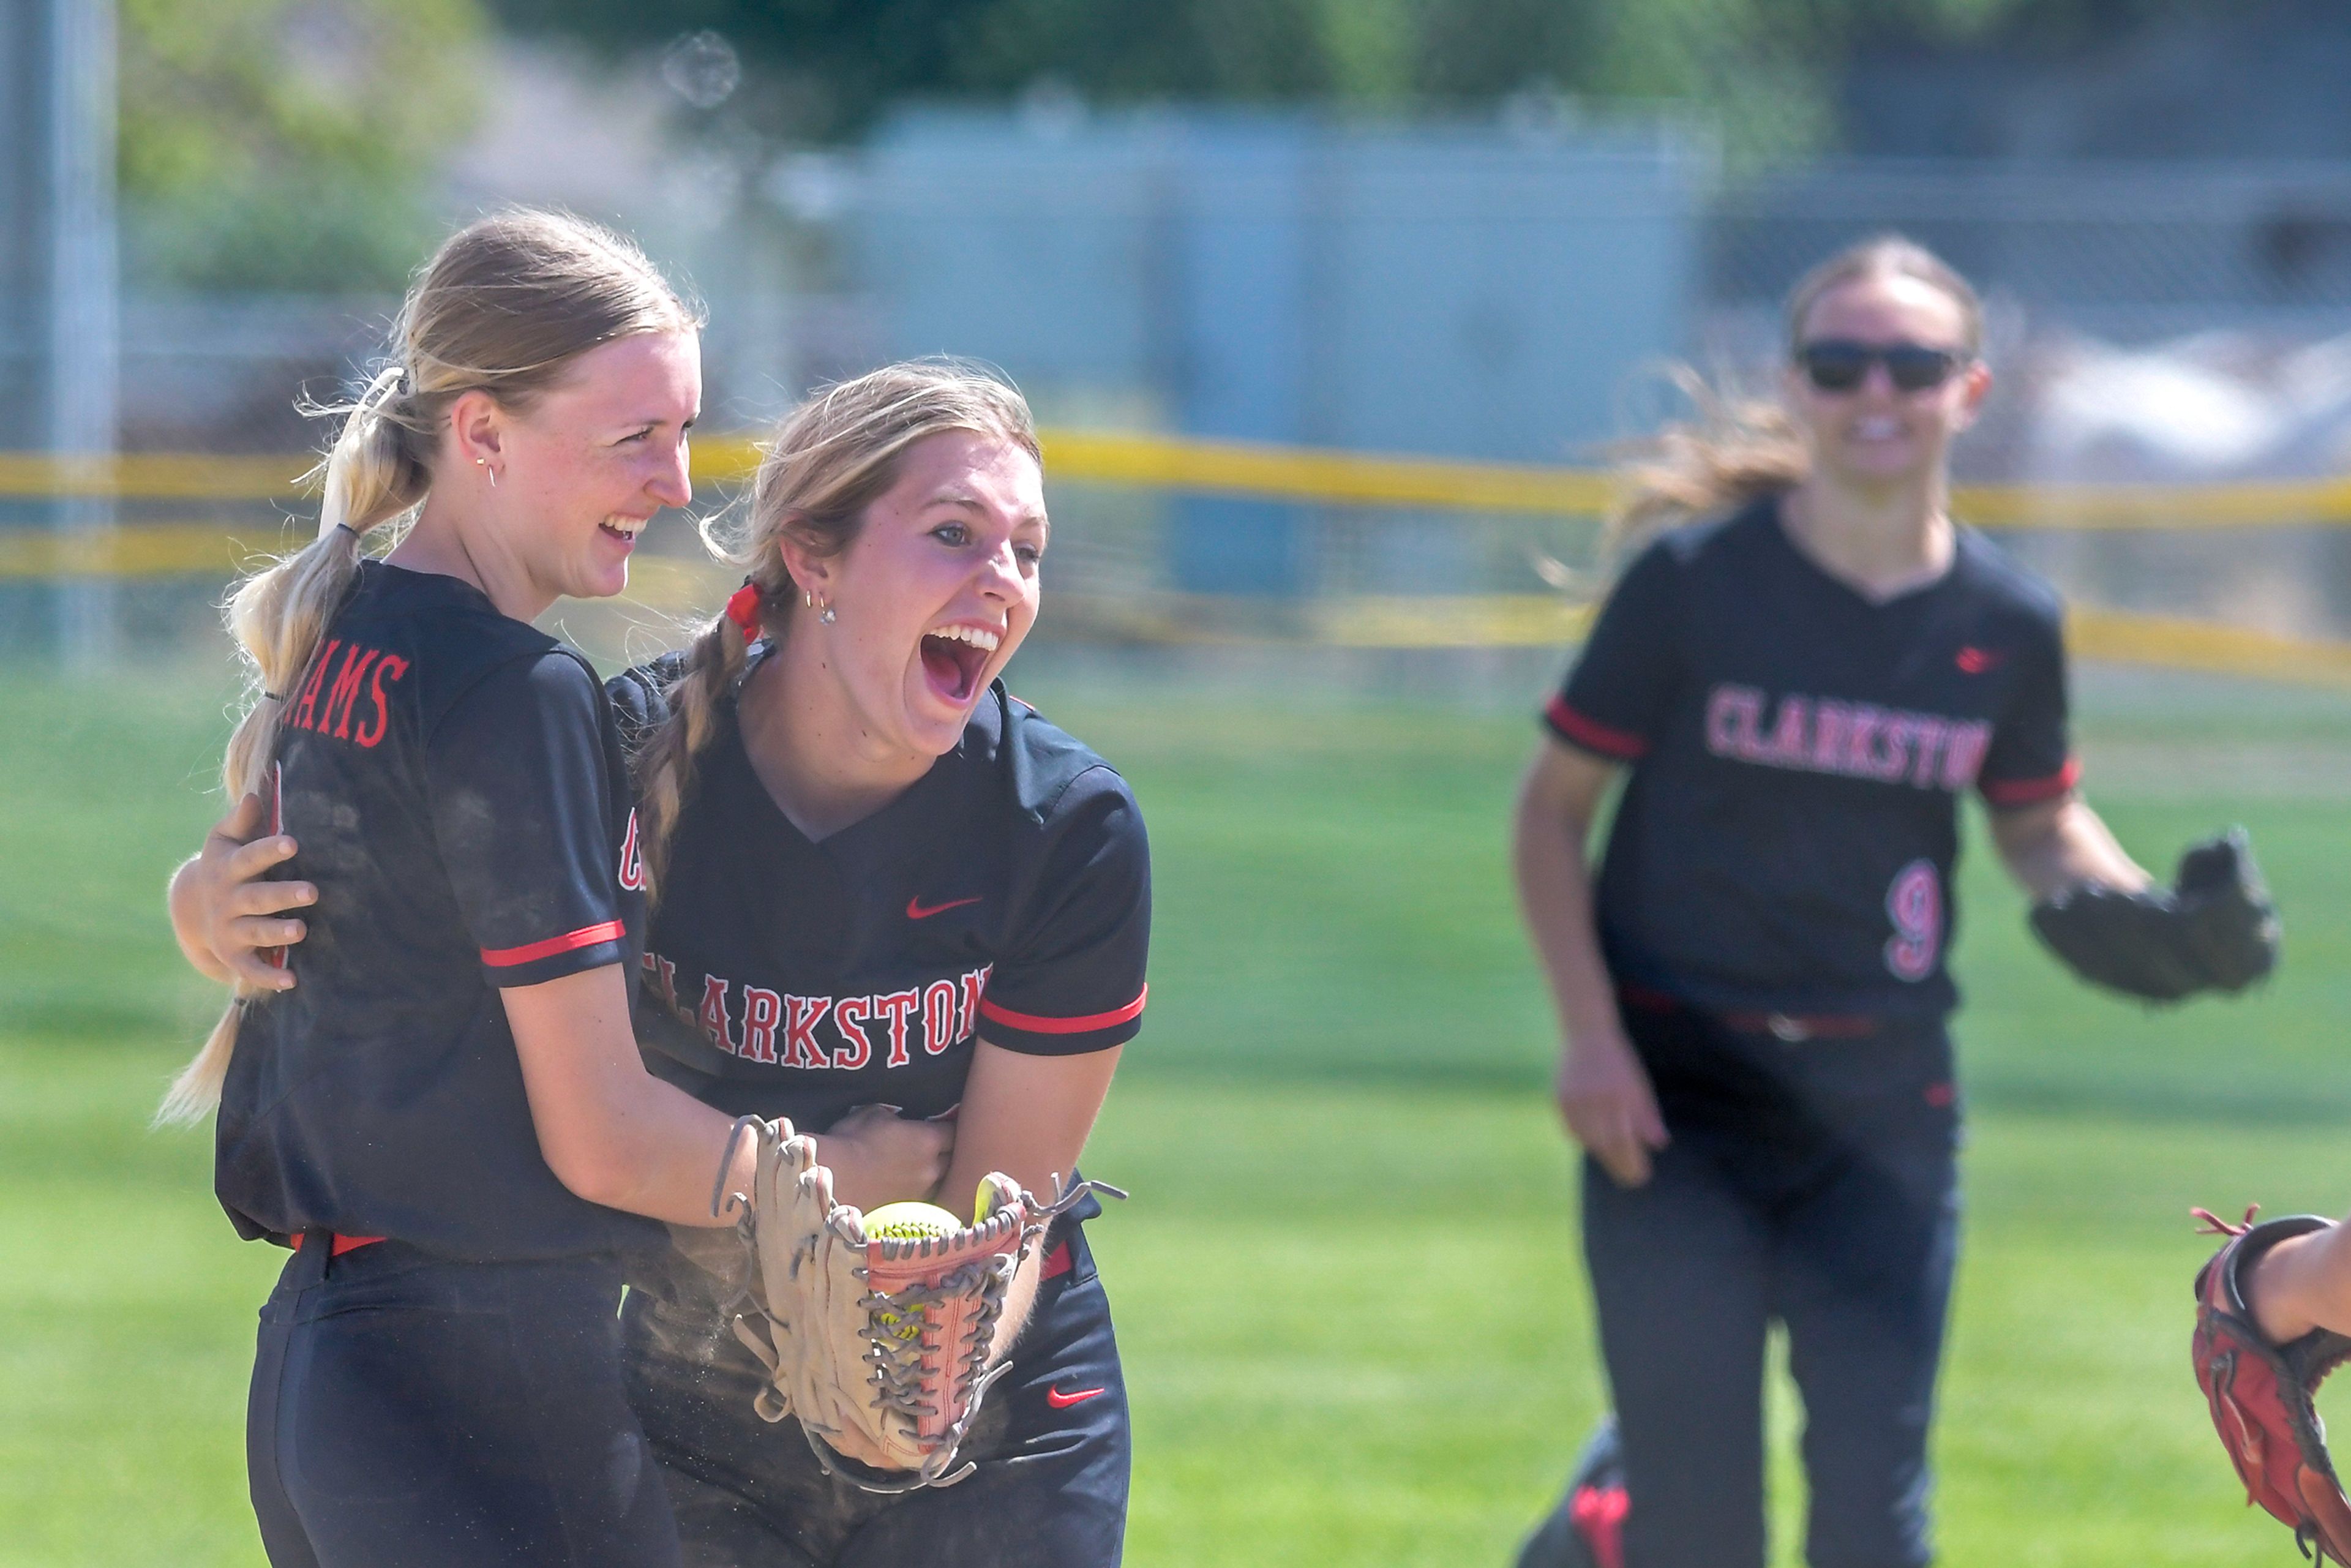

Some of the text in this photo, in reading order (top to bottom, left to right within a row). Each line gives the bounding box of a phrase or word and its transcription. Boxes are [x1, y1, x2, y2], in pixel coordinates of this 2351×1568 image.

[284, 639, 410, 747] AMS
[1886, 859, 1941, 981] 9
[642, 952, 994, 1070] LARKSTON
